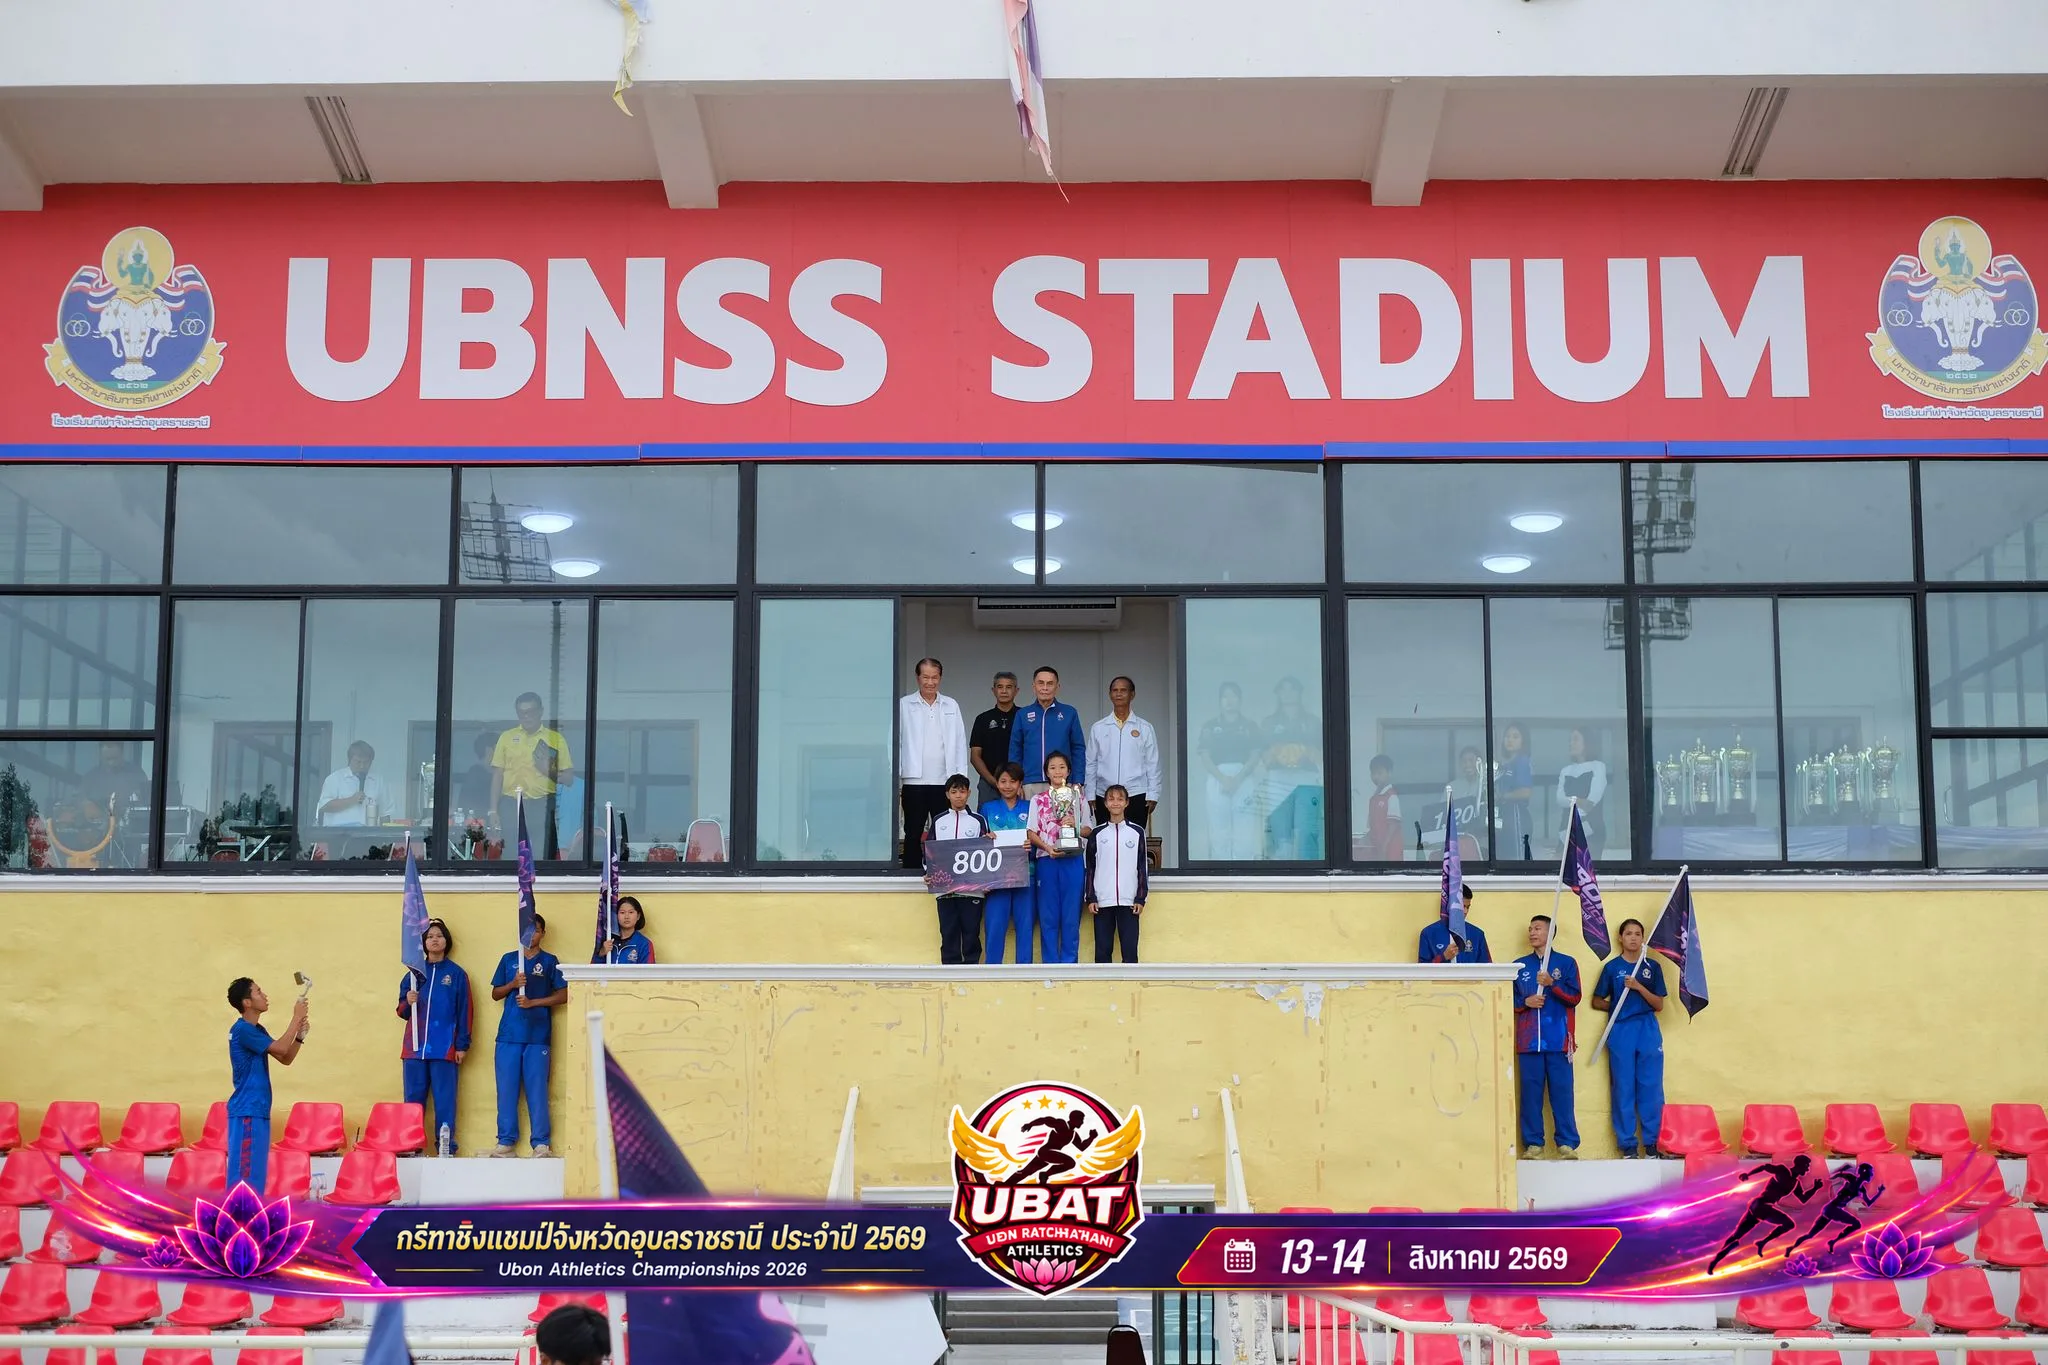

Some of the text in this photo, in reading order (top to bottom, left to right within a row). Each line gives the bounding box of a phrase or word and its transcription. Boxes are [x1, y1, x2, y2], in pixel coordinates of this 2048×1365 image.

[286, 255, 1810, 406] UBNSS STADIUM
[953, 849, 1002, 874] 800
